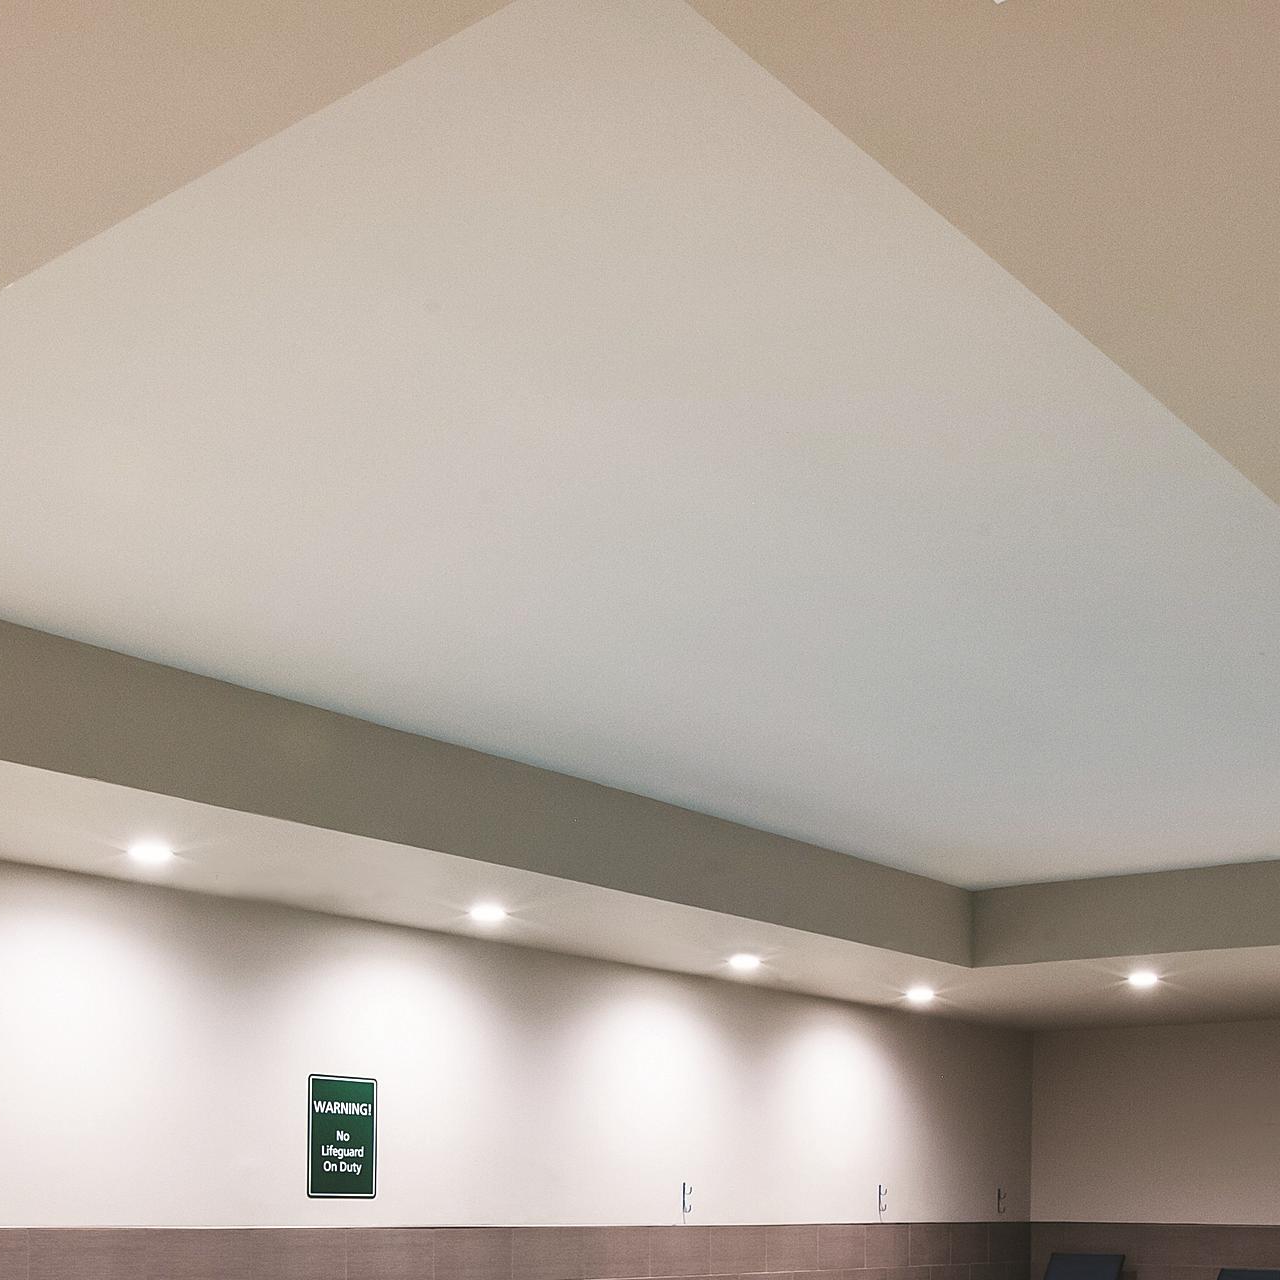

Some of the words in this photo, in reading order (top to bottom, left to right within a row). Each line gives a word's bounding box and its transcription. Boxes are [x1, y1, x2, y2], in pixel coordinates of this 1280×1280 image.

[313, 1100, 372, 1116] WARNING!
[336, 1130, 350, 1142] No
[321, 1145, 364, 1159] Lifeguard
[323, 1161, 337, 1172] On
[339, 1161, 362, 1175] Duty
